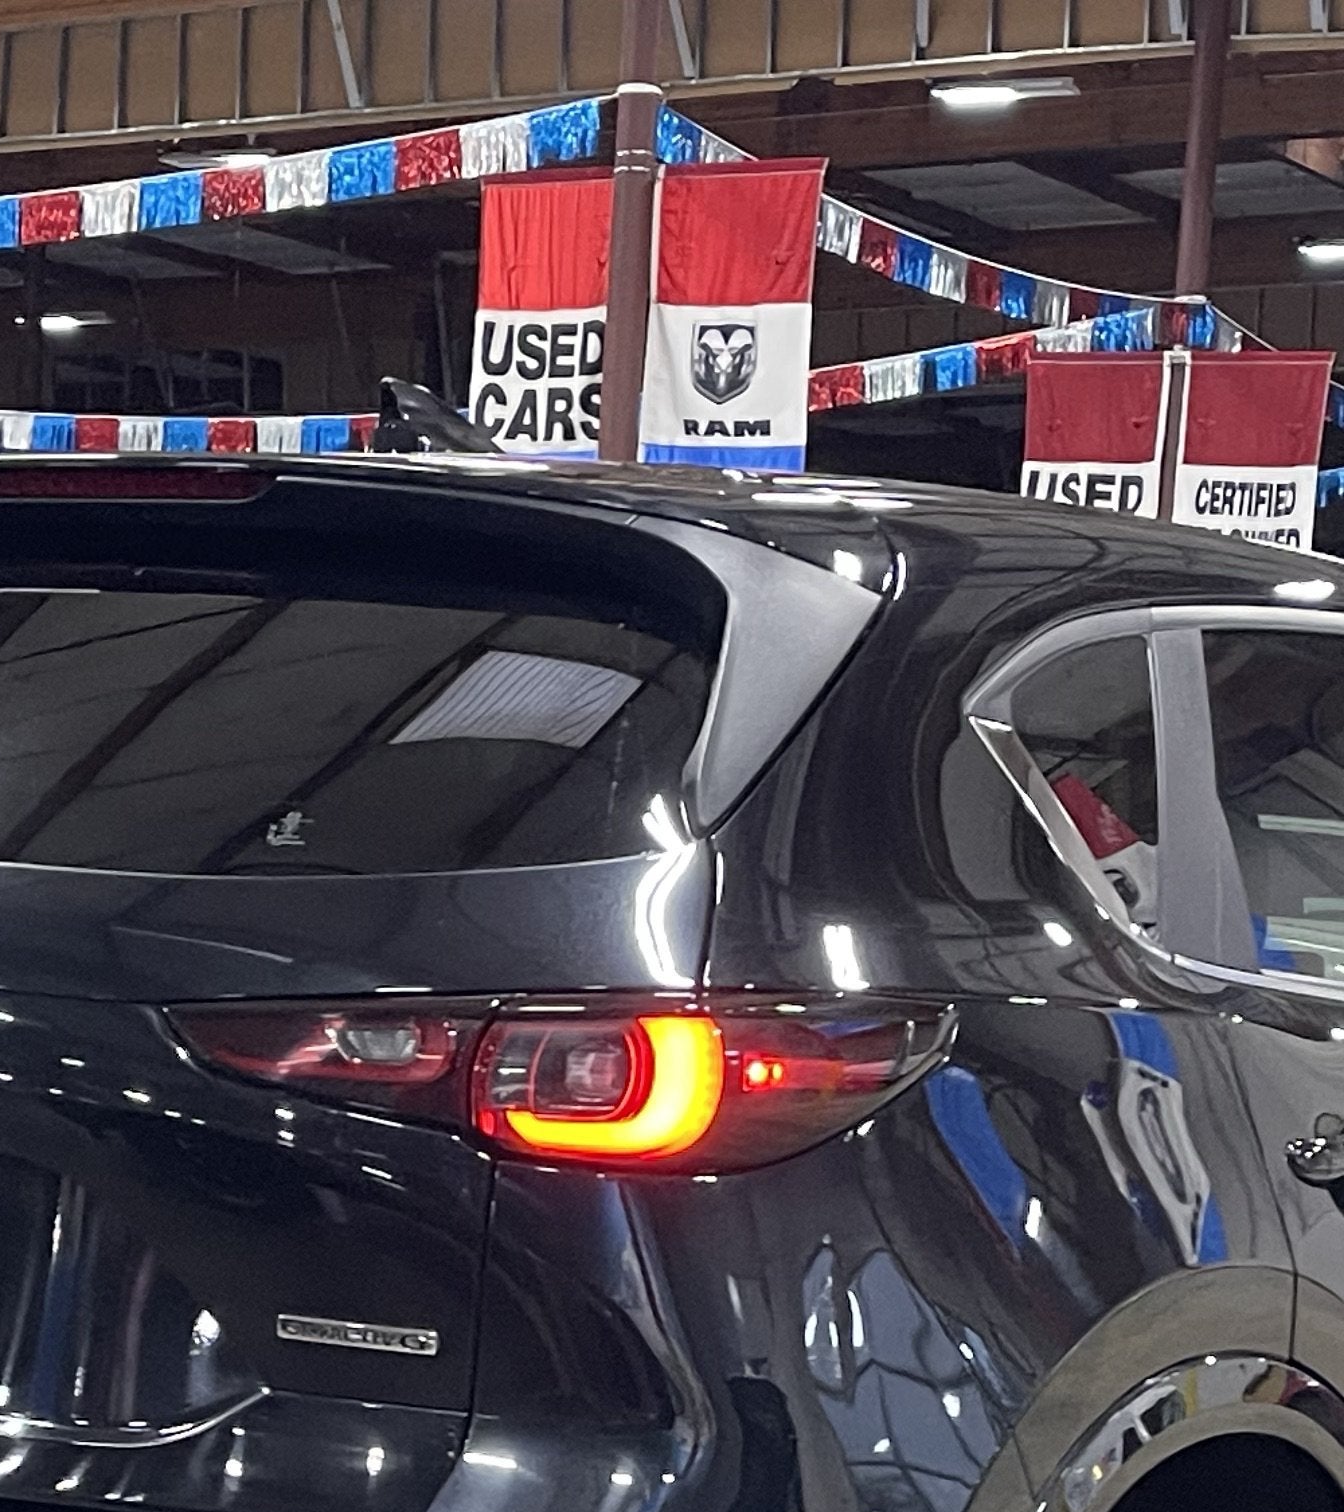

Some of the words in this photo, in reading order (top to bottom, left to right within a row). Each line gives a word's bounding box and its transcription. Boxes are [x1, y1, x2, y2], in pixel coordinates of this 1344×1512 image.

[482, 320, 605, 380] USED
[476, 382, 601, 441] CARS
[683, 418, 771, 437] RAM
[1194, 478, 1297, 517] CERTIFIED
